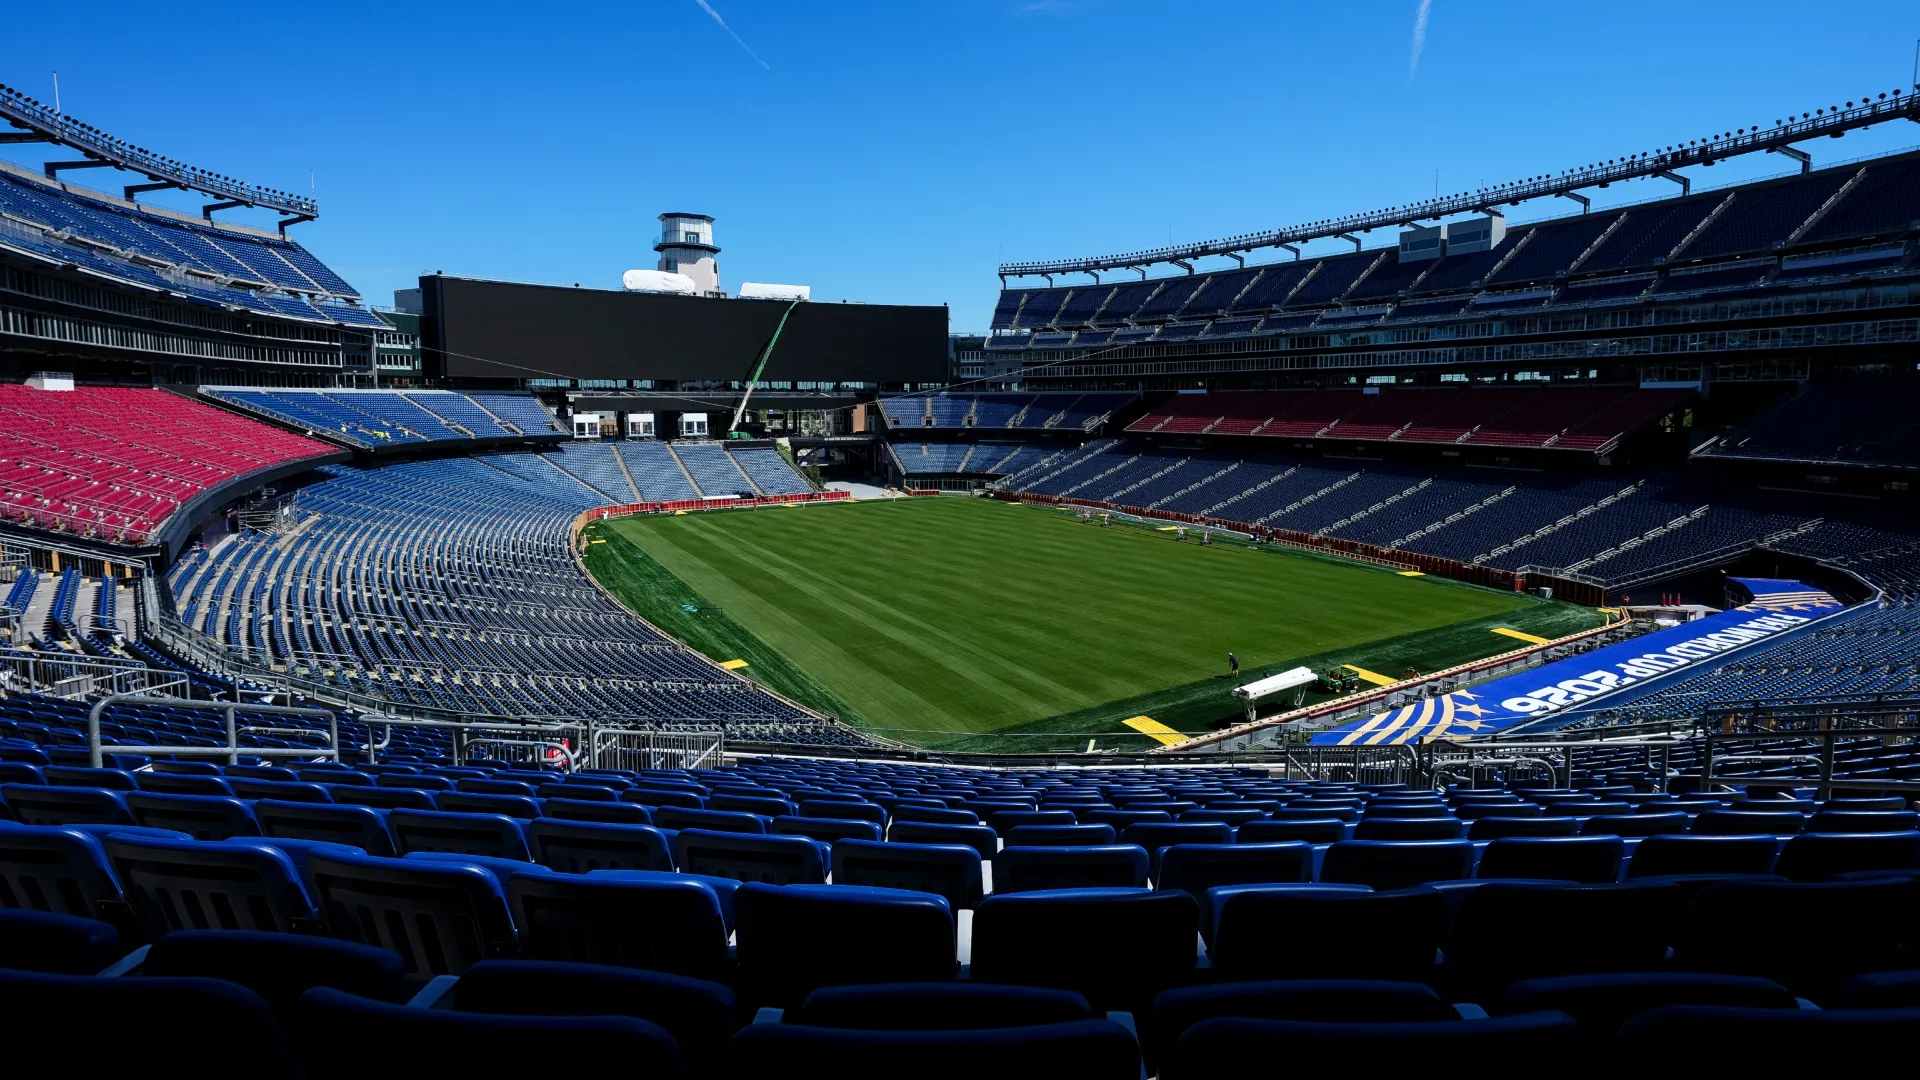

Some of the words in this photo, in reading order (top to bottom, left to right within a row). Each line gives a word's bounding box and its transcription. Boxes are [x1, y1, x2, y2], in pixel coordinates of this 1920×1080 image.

[1665, 627, 1771, 659] WORLD
[1615, 653, 1691, 677] CUP
[1501, 670, 1636, 716] 2026
